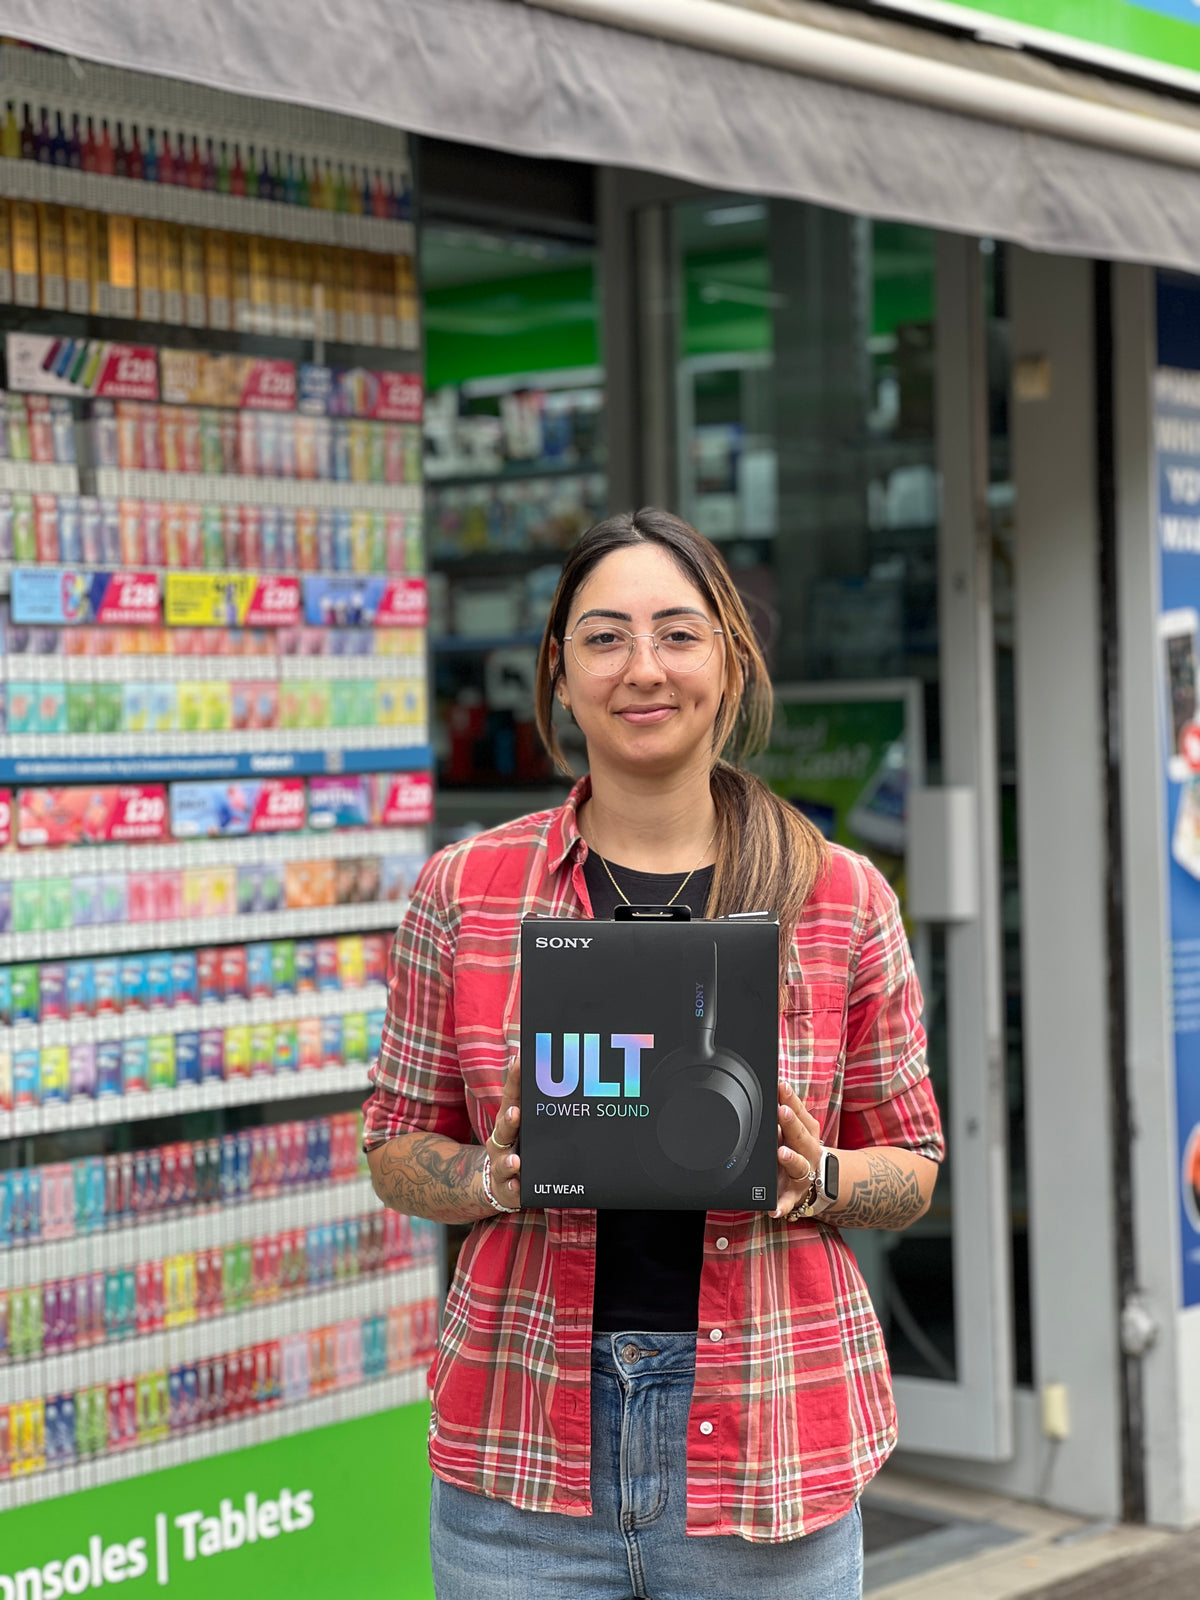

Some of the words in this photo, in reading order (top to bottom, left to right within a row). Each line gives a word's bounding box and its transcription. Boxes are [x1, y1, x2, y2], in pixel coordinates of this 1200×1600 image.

[535, 937, 593, 949] SONY
[695, 982, 704, 1018] SONY
[535, 1033, 654, 1098] ULT
[536, 1104, 590, 1117] POWER
[596, 1104, 650, 1118] SOUND
[534, 1184, 552, 1194] ULT
[553, 1184, 585, 1195] WEAR
[174, 1488, 314, 1561] Tablets
